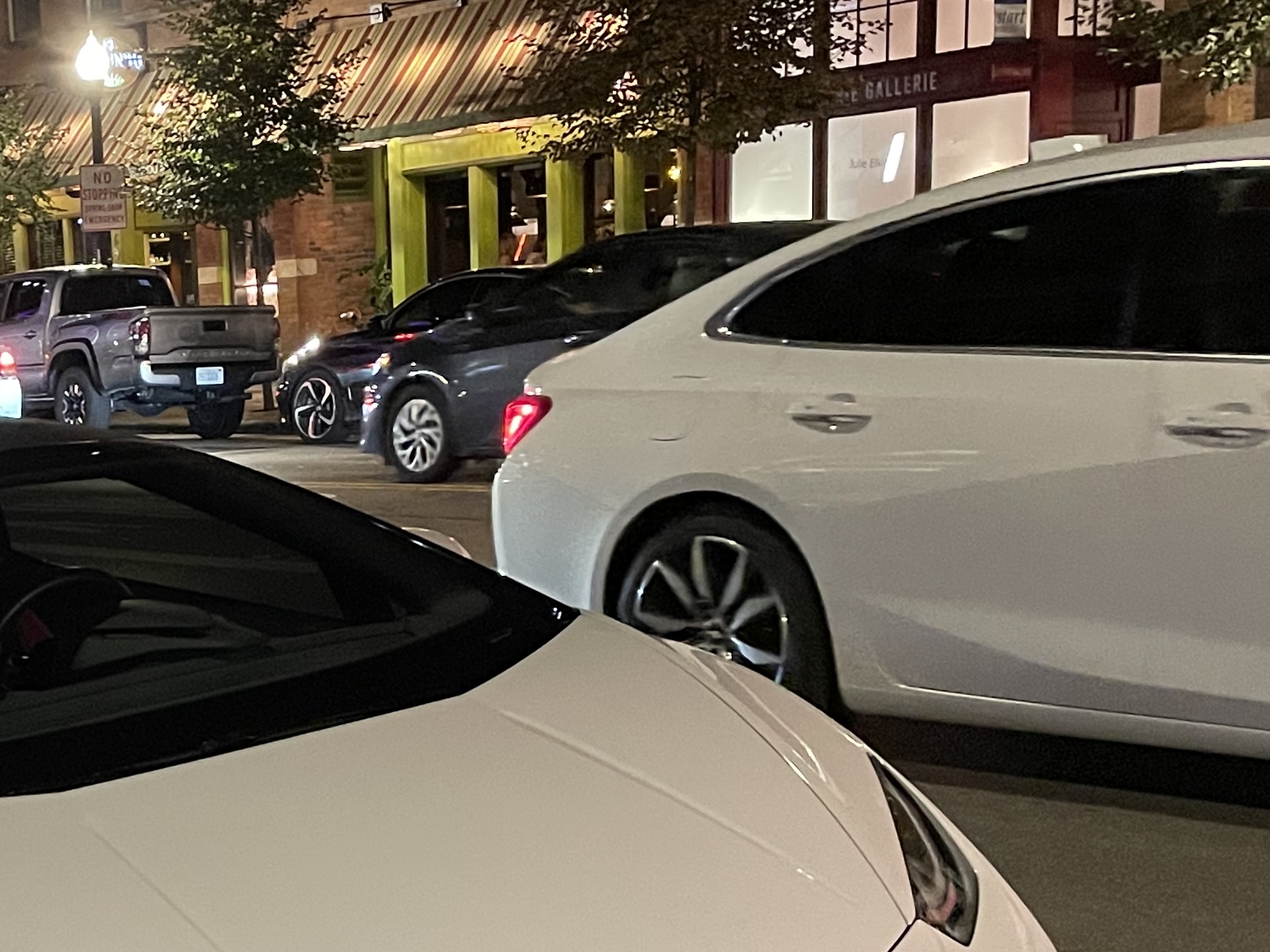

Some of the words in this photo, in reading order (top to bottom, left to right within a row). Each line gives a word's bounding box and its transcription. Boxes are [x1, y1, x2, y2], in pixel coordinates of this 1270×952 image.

[996, 9, 1026, 24] start
[865, 71, 937, 100] GALLERIE
[849, 158, 868, 169] Julie
[93, 171, 112, 184] NO
[85, 214, 124, 224] EMERGENCY
